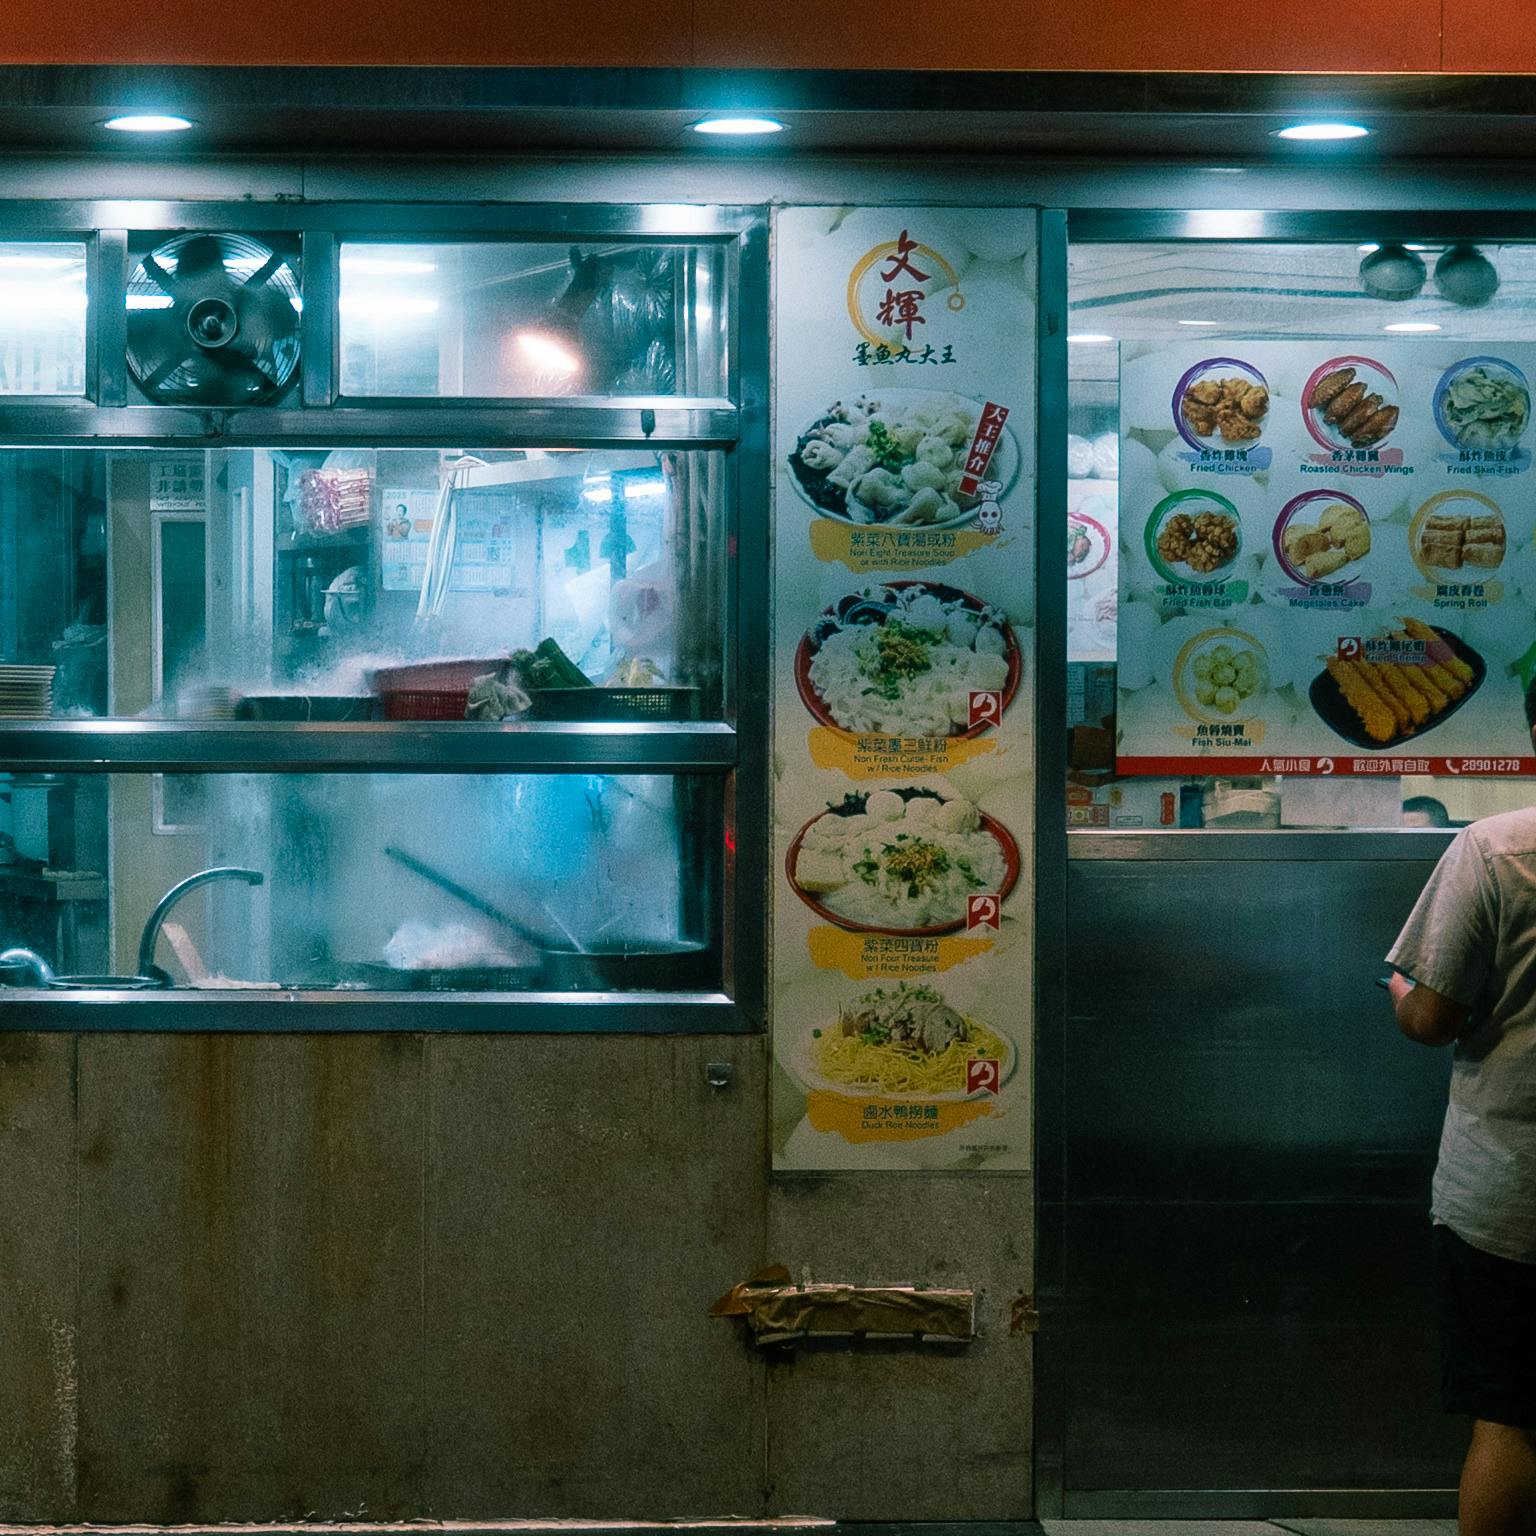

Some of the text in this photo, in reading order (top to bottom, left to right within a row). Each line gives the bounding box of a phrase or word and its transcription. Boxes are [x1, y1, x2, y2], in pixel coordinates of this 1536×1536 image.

[875, 229, 932, 341] 文輝
[852, 341, 957, 365] 墨魚丸大王
[966, 406, 1008, 471] 大王推介
[1190, 464, 1257, 472] Fried Chicken
[1300, 465, 1414, 475] Roasted Chicken Wings
[1447, 466, 1472, 474] Fried
[894, 549, 931, 557] Treasure
[1163, 599, 1232, 607] Fried Fish Ball
[1341, 599, 1365, 607] Cake
[1434, 599, 1488, 609] Spring Roll
[1192, 738, 1252, 746] Fish Siu-Mai
[930, 755, 949, 763] Fish
[882, 765, 901, 773] Rice
[903, 765, 938, 773] Noodles
[1259, 759, 1311, 772] 人氣小食
[881, 954, 899, 962] Four
[902, 954, 939, 962] Treasure
[881, 964, 900, 972] Rice
[902, 964, 937, 972] Noodles
